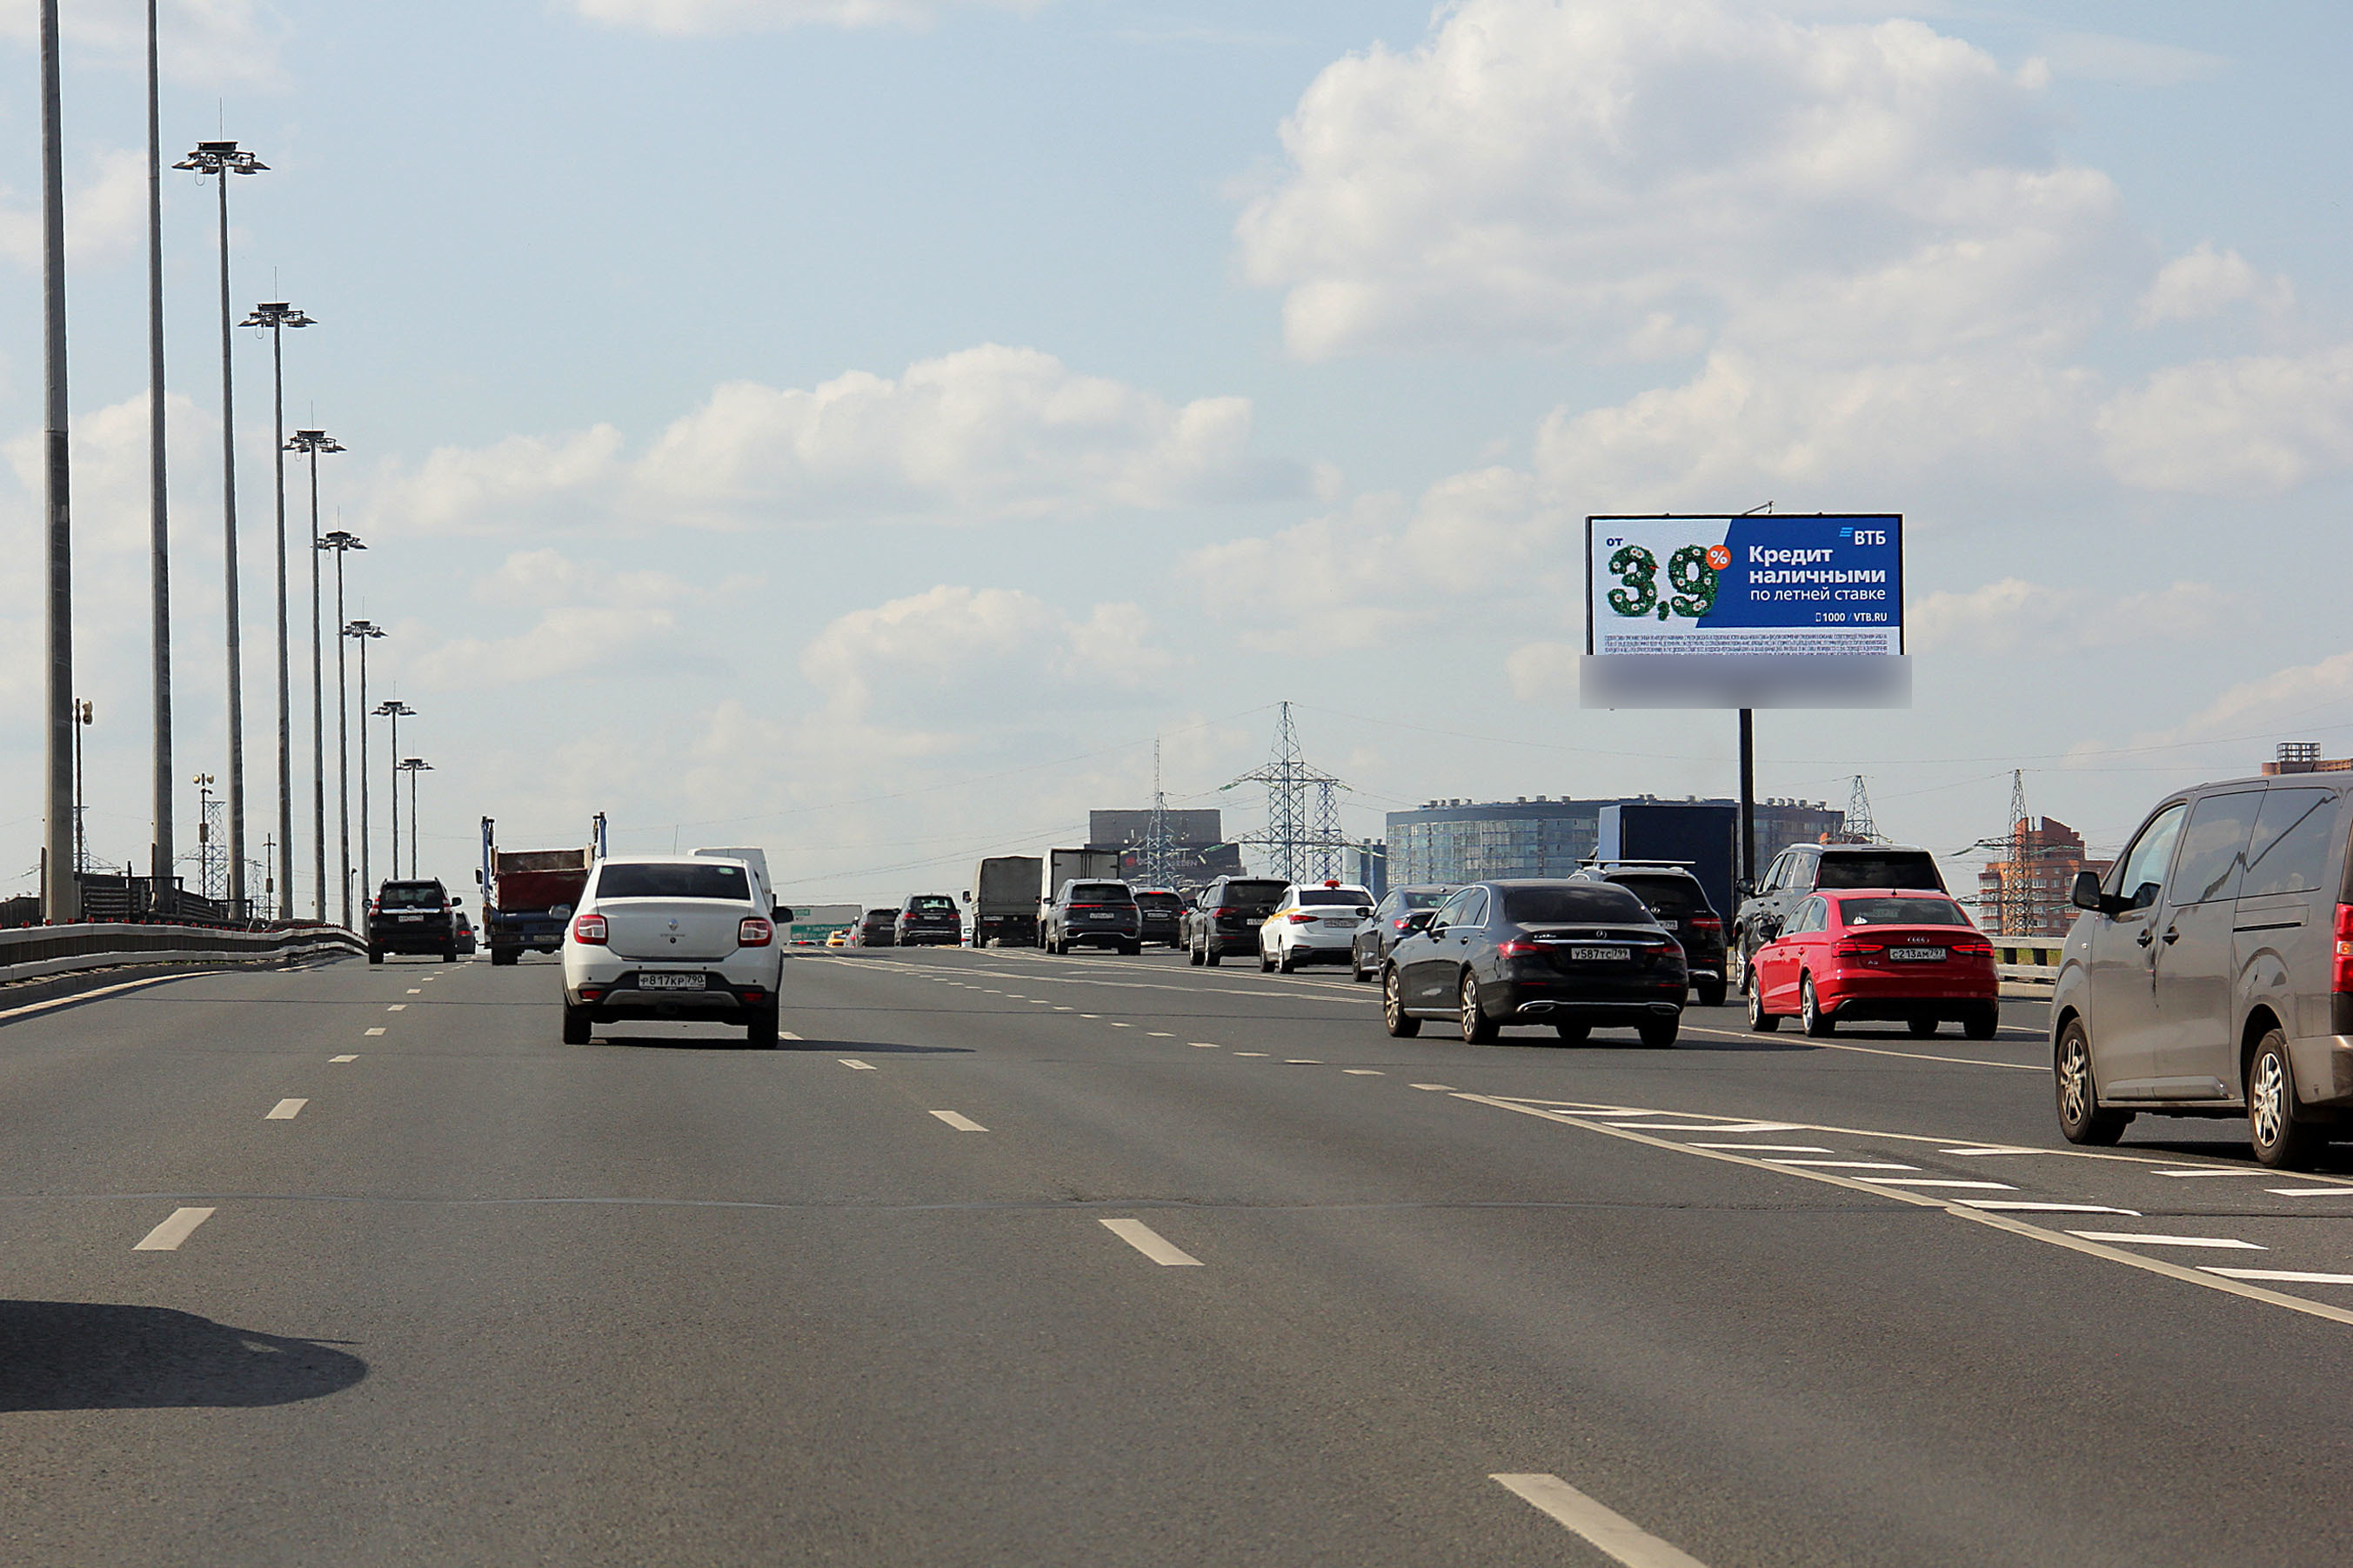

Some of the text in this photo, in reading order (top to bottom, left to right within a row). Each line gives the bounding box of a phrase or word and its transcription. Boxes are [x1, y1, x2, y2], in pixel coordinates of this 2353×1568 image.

[1606, 537, 1623, 547] от
[1855, 530, 1886, 546] ВТБ
[1748, 544, 1833, 567] Кредит
[1748, 570, 1886, 584] наличными
[1750, 586, 1886, 602] по летней ставке
[1822, 612, 1846, 623] 1000
[1854, 612, 1888, 623] VTB.RU
